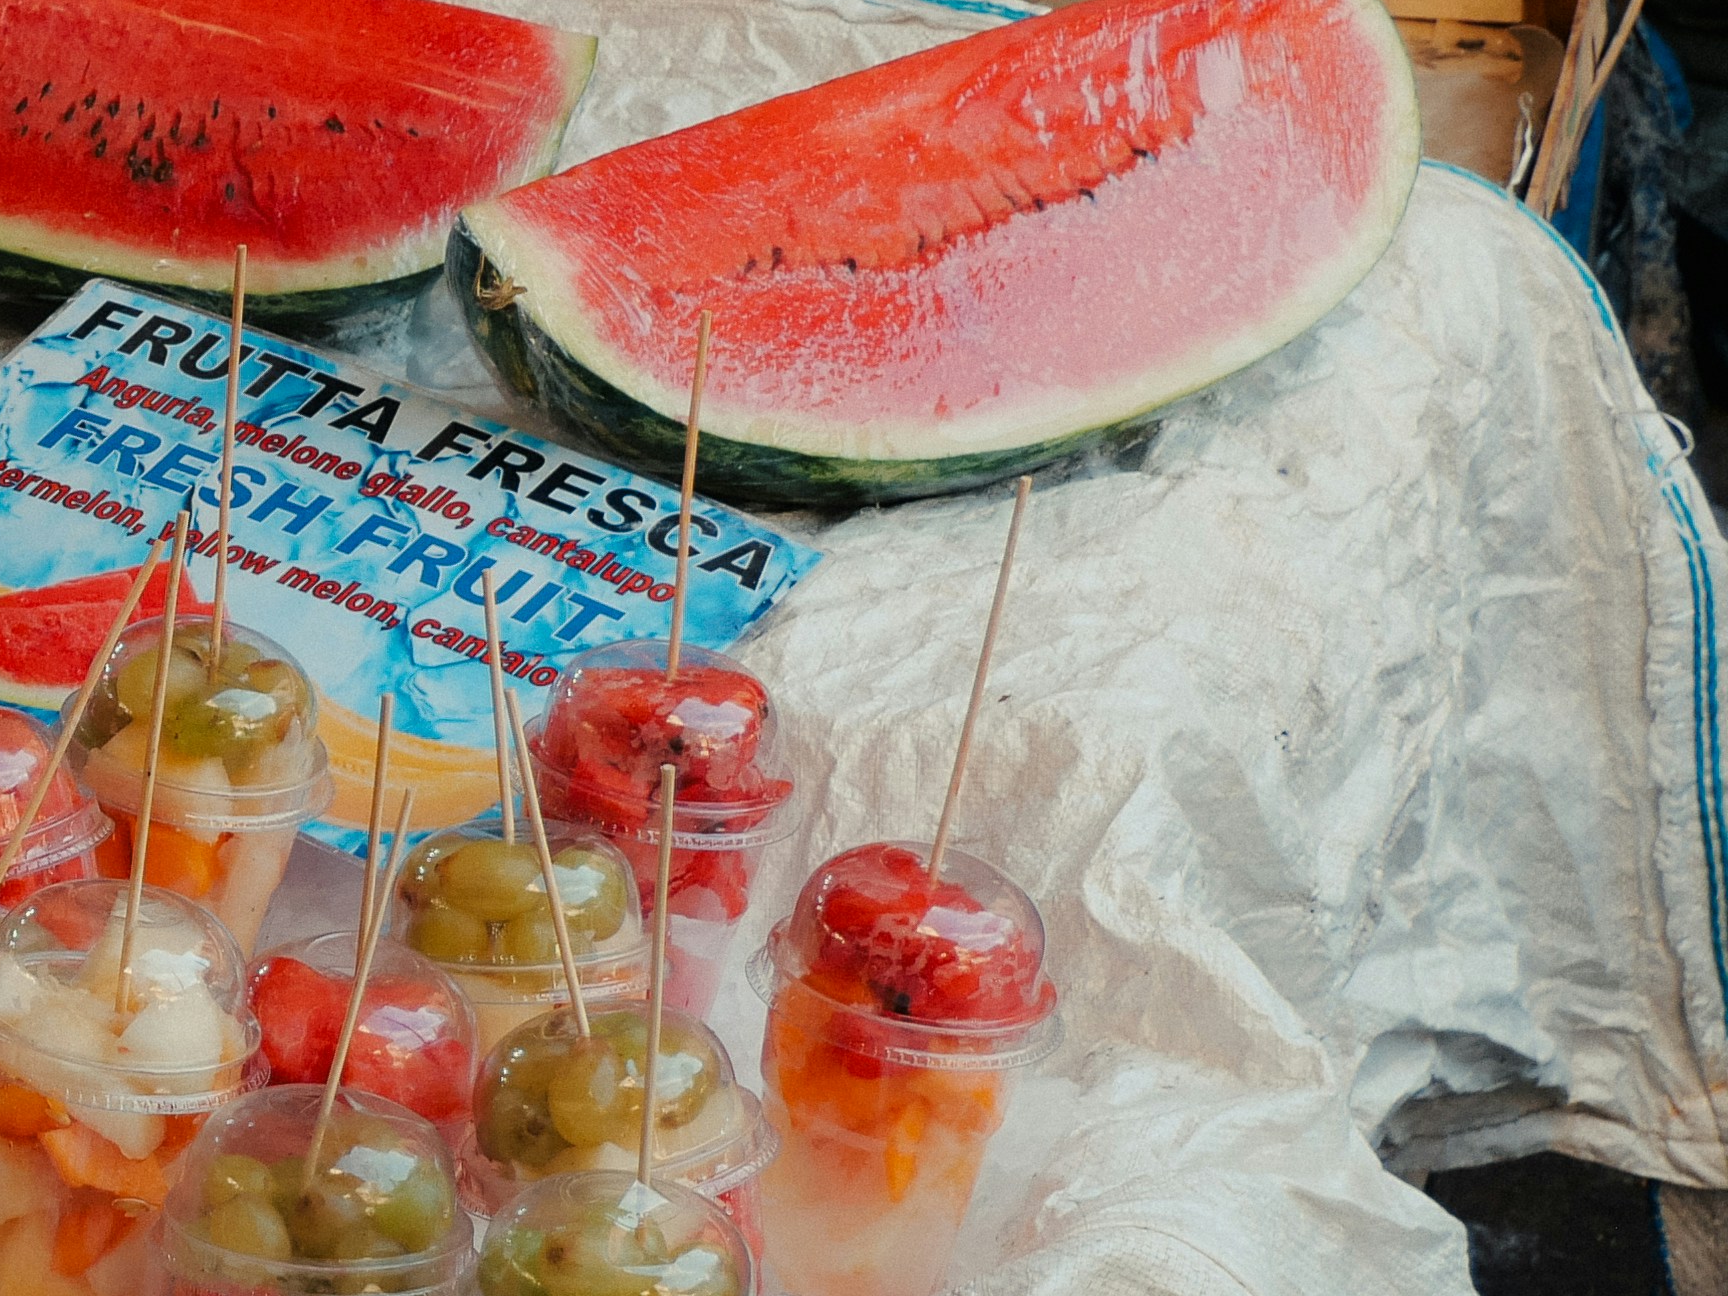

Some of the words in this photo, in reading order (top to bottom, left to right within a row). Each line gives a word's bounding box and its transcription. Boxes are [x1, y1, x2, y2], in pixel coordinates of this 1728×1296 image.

[36, 405, 326, 539] FRESH
[332, 512, 627, 645] FRUIT
[67, 299, 404, 446] FRUTTA
[414, 418, 781, 593] FRESCA
[73, 363, 217, 437] Anguria,
[233, 418, 355, 481] melone
[360, 462, 474, 531] giallo,
[485, 513, 678, 605] cantalupo
[276, 556, 406, 633] melon,
